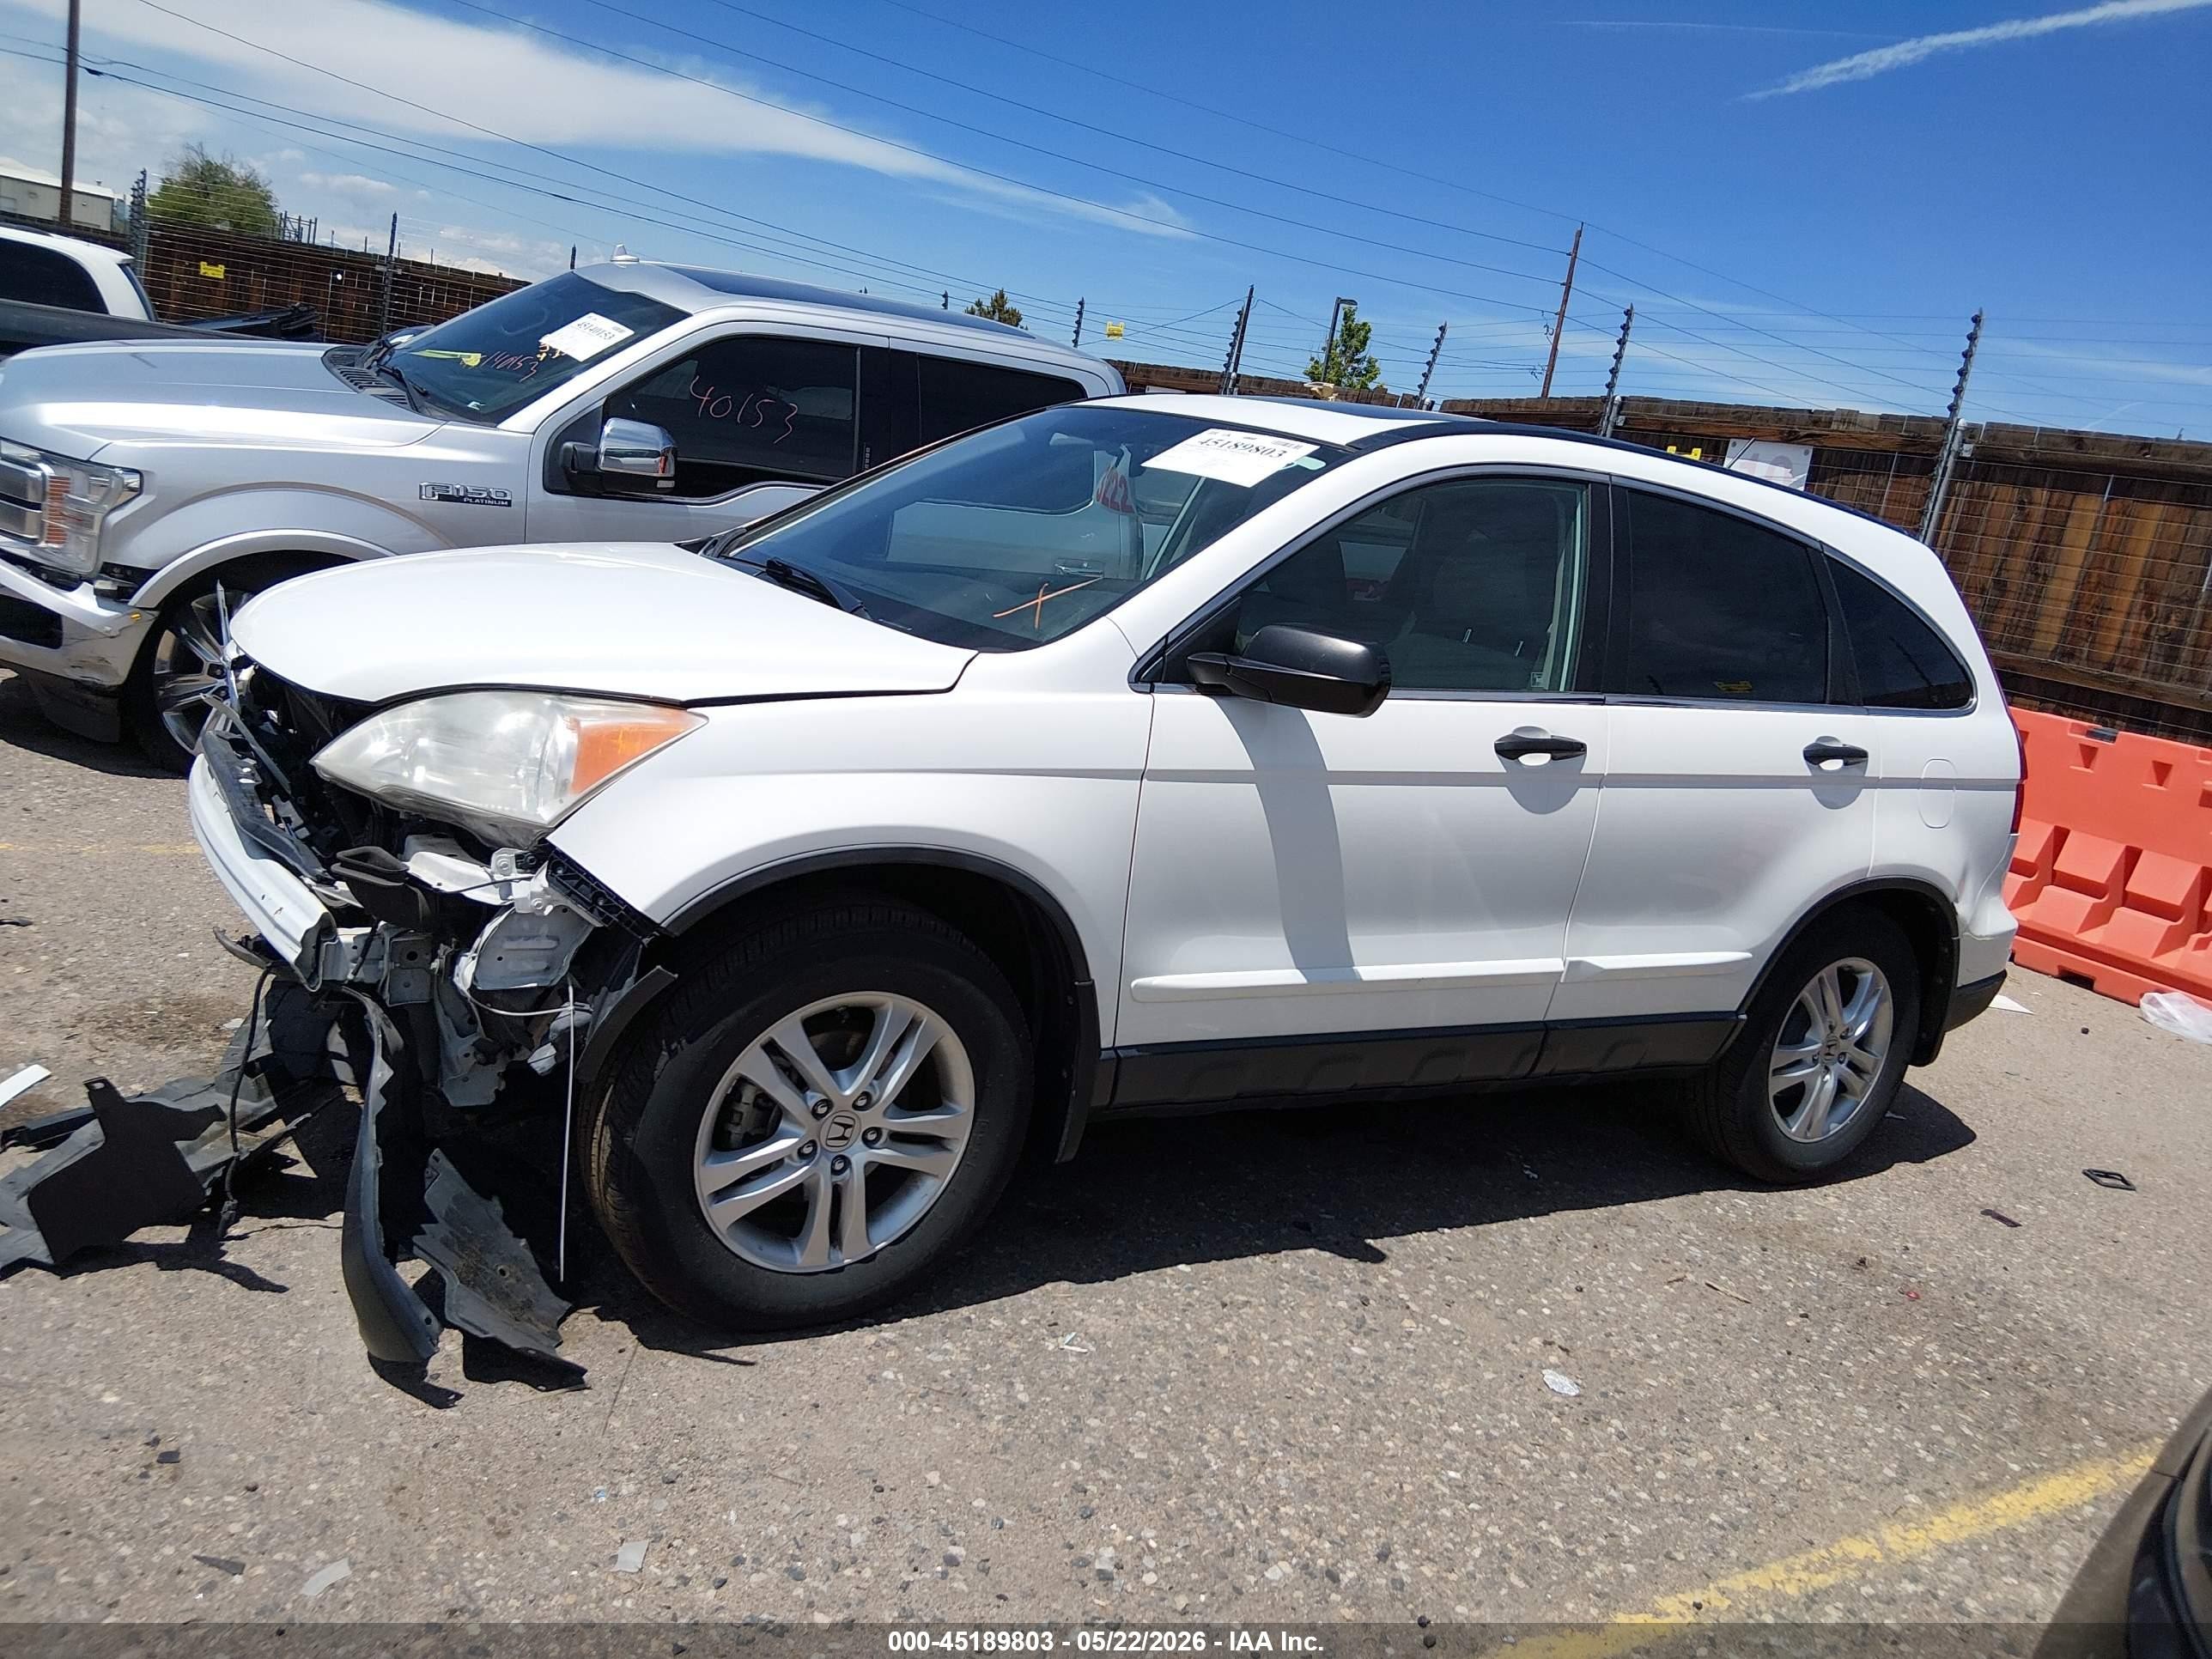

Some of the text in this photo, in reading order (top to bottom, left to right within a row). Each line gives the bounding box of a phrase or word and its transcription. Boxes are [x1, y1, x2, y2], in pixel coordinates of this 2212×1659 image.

[690, 374, 799, 445] 40153
[1198, 437, 1288, 459] 45189803
[464, 497, 508, 507] PLATINUM
